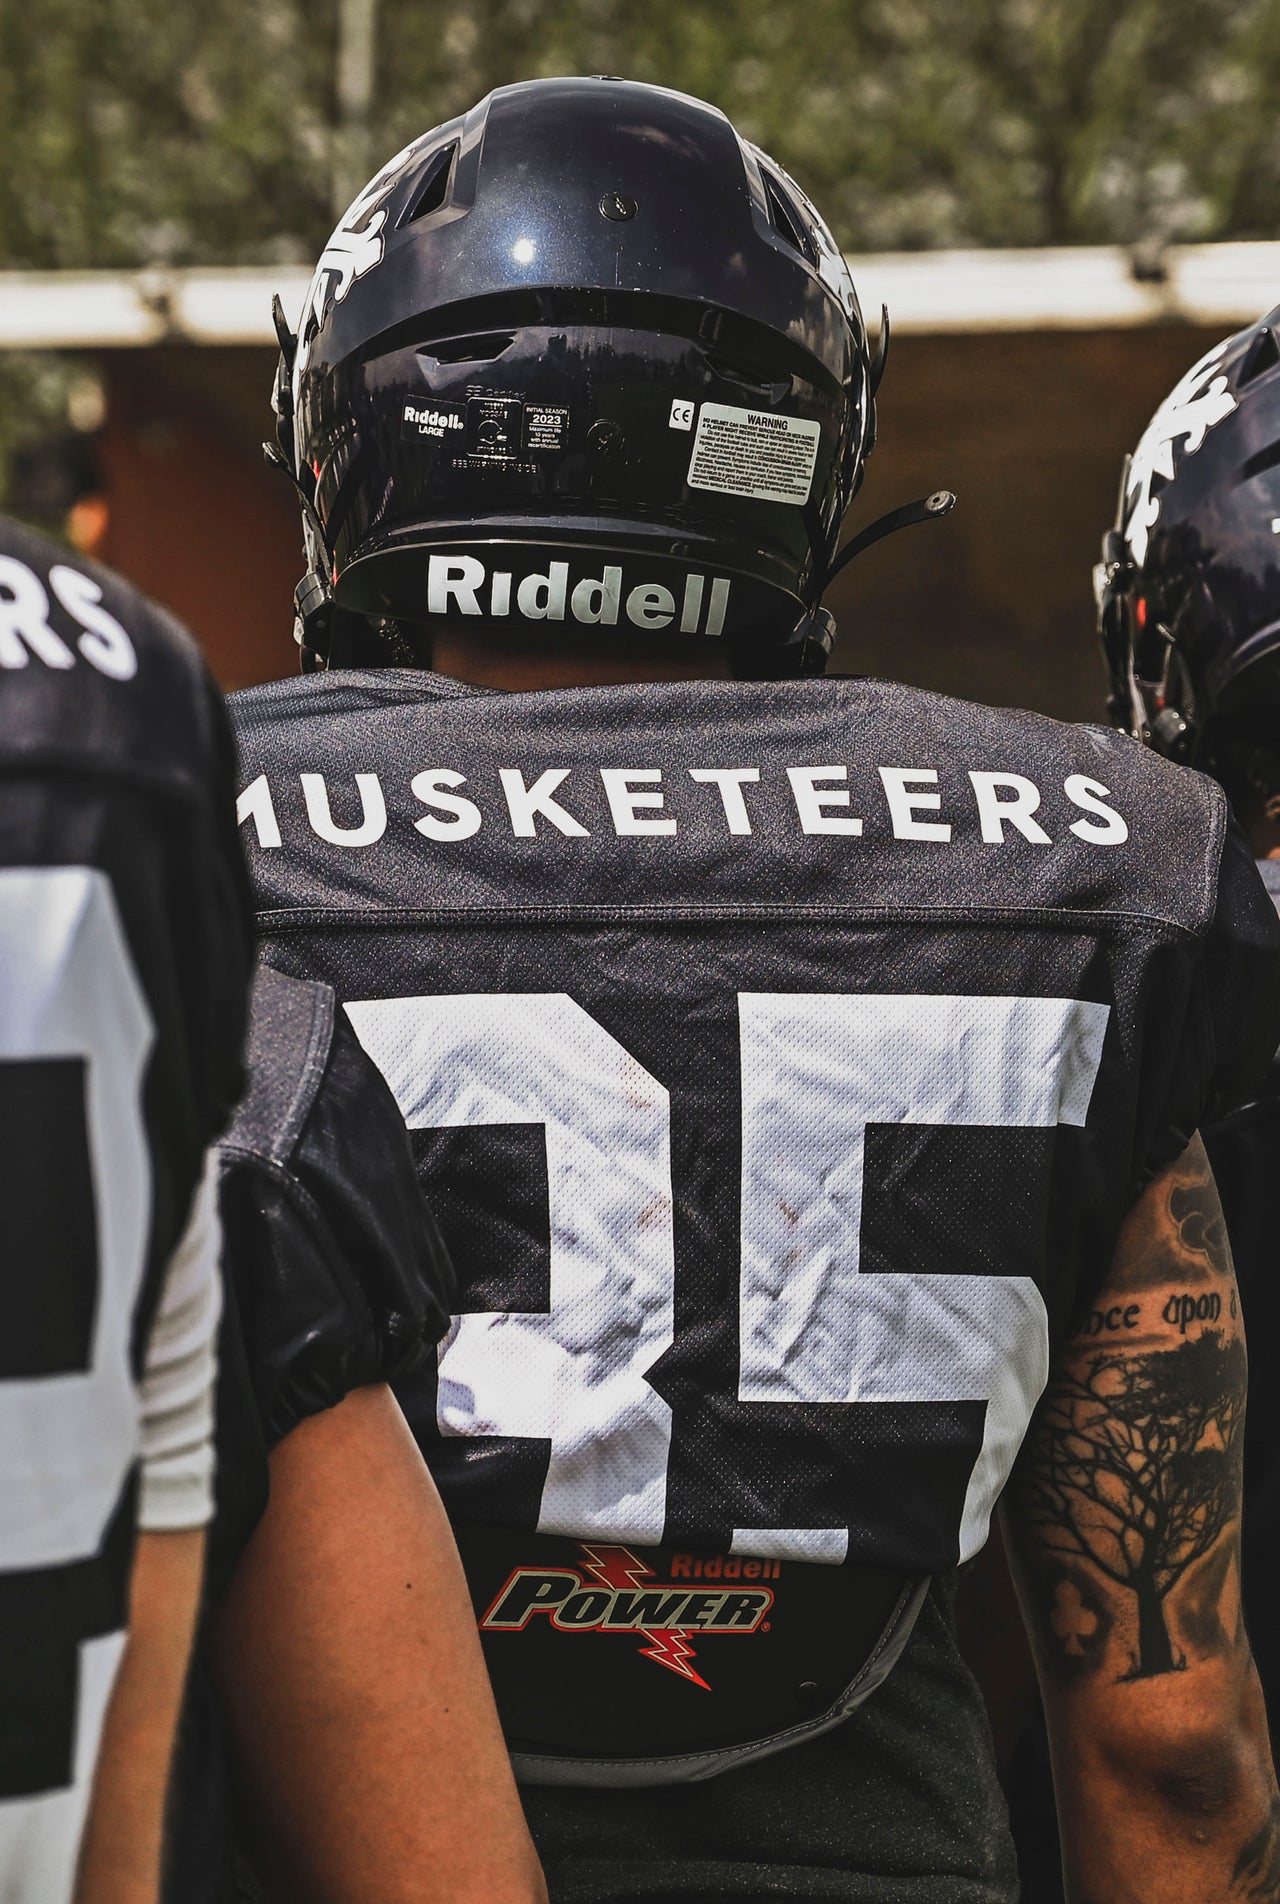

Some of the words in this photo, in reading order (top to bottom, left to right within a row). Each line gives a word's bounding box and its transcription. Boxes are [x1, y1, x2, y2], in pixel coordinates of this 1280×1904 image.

[404, 406, 457, 430] Riddell
[532, 414, 561, 425] 2023
[747, 414, 789, 430] WARNING
[418, 426, 444, 438] LARGE
[426, 553, 730, 637] Riddell
[342, 991, 1112, 1566] 35
[669, 1552, 782, 1580] Riddell
[478, 1566, 776, 1634] POWER
